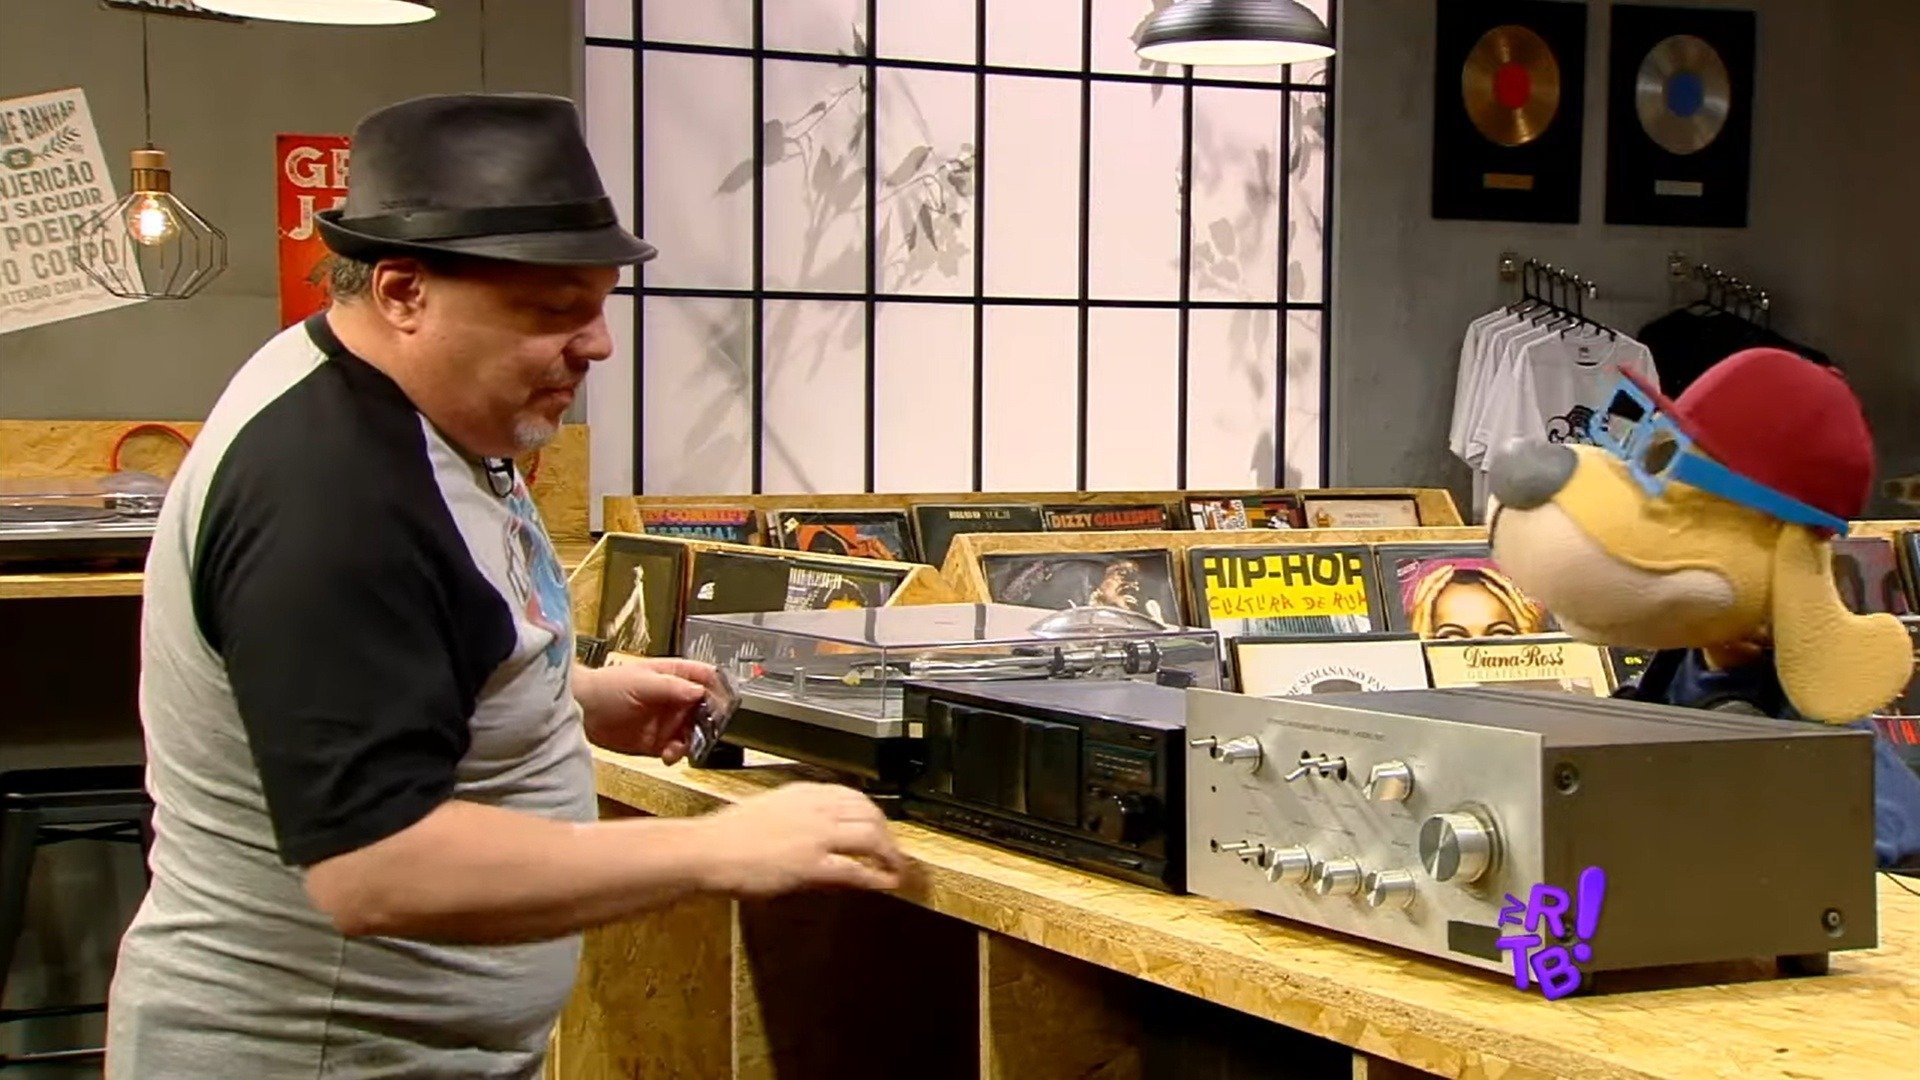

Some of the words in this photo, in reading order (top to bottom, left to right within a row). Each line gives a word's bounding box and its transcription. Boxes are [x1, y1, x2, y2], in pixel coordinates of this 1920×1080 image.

[14, 187, 103, 219] SACUDIR
[31, 238, 119, 280] CORPO
[1051, 513, 1092, 528] DIZZY
[1202, 552, 1364, 589] HIP-HOP
[1209, 593, 1294, 616] CULTURA
[1302, 596, 1326, 610] DE
[1463, 646, 1519, 668] Diana
[1521, 644, 1565, 667] Ross
[1346, 667, 1366, 681] NO
